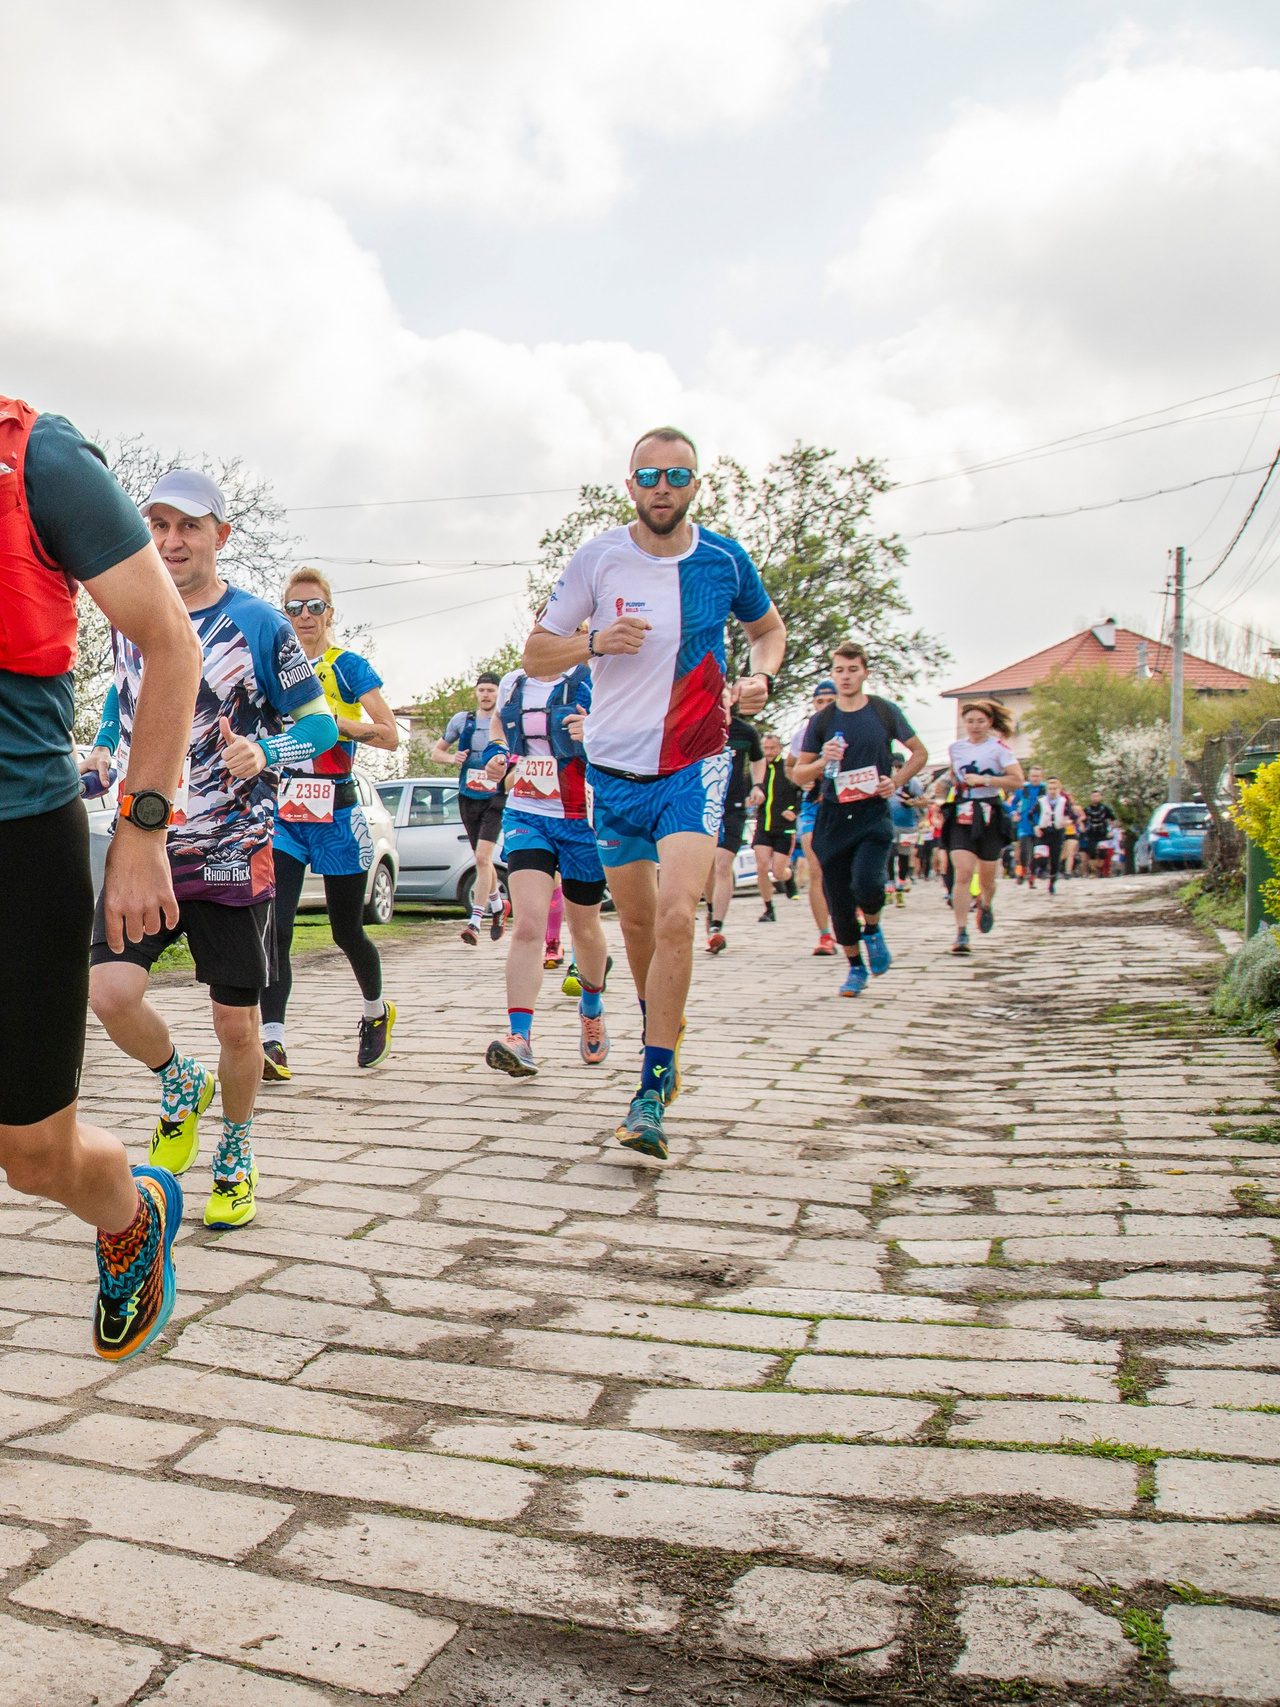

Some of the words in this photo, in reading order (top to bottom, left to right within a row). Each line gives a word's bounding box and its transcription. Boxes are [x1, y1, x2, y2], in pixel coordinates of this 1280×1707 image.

[278, 662, 311, 690] RHODO
[526, 761, 554, 777] 2372
[296, 783, 331, 799] 2398
[203, 866, 231, 882] RHODO
